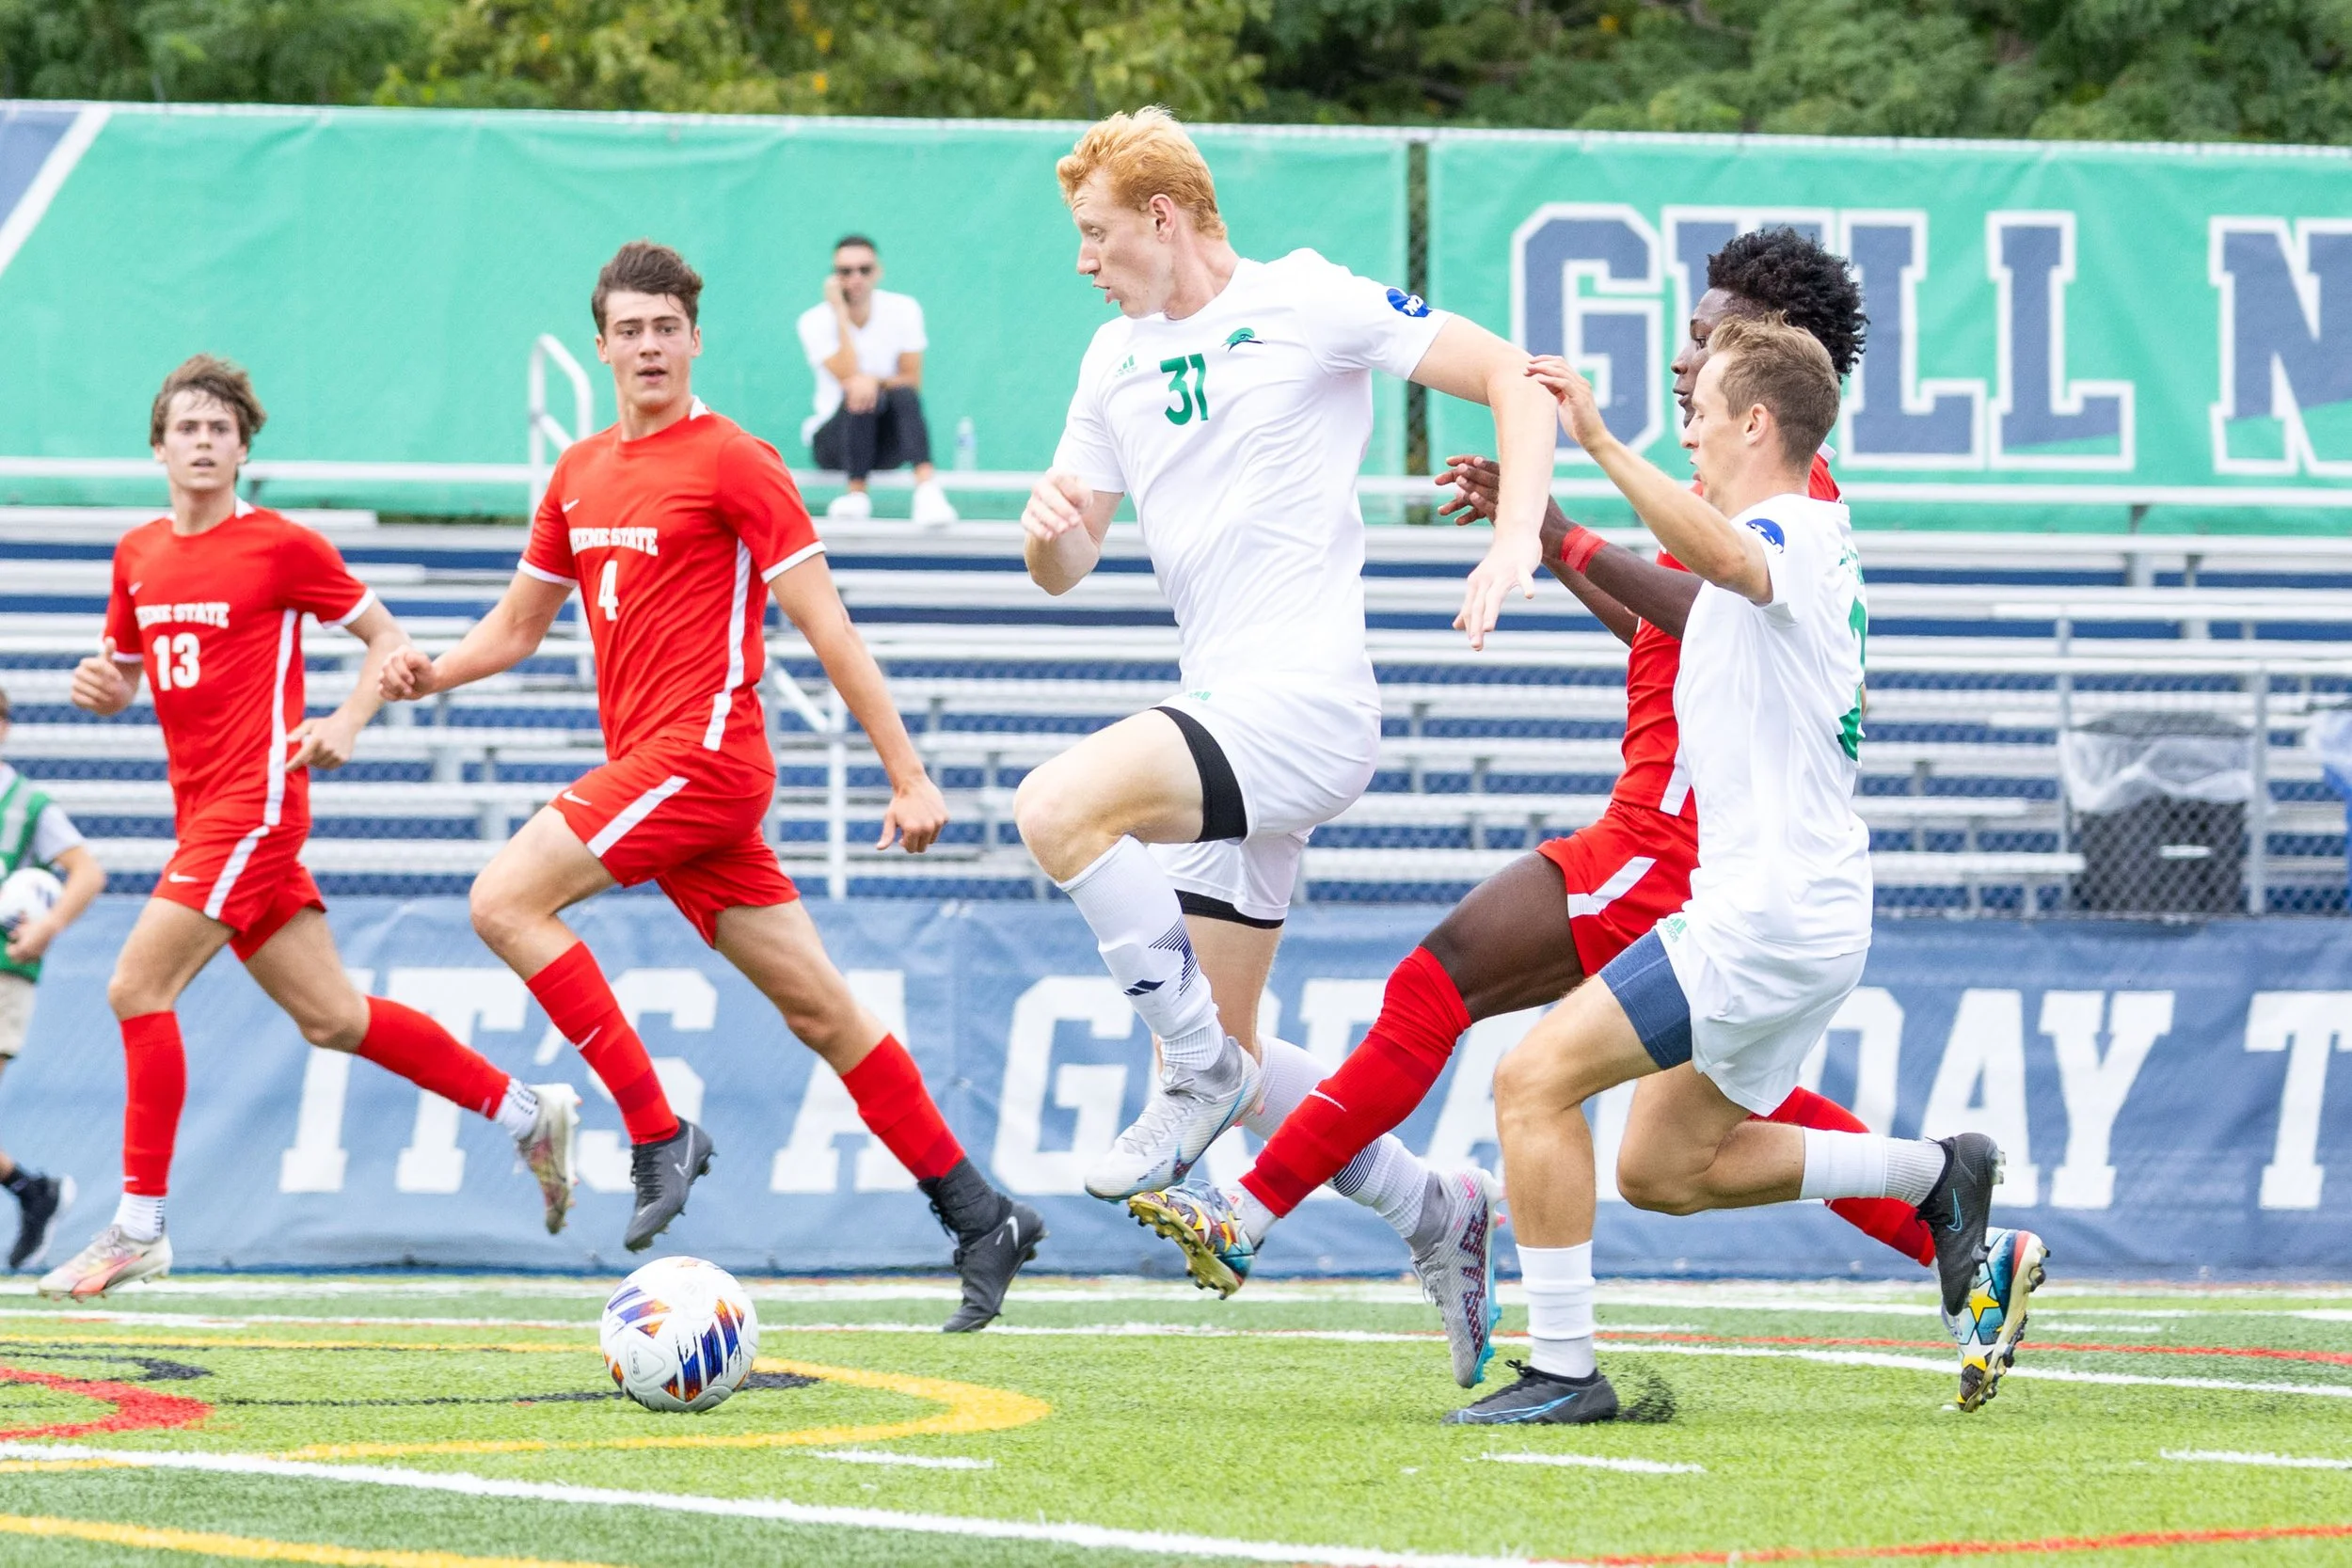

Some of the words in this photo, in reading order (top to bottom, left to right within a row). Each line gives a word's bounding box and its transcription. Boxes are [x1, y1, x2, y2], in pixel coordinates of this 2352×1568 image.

[1160, 353, 1209, 425] 31
[610, 527, 659, 557] STATE
[172, 602, 230, 629] STATE
[597, 560, 619, 621] 4
[152, 632, 200, 691] 13
[769, 969, 922, 1196] A
[2245, 990, 2352, 1211] T
